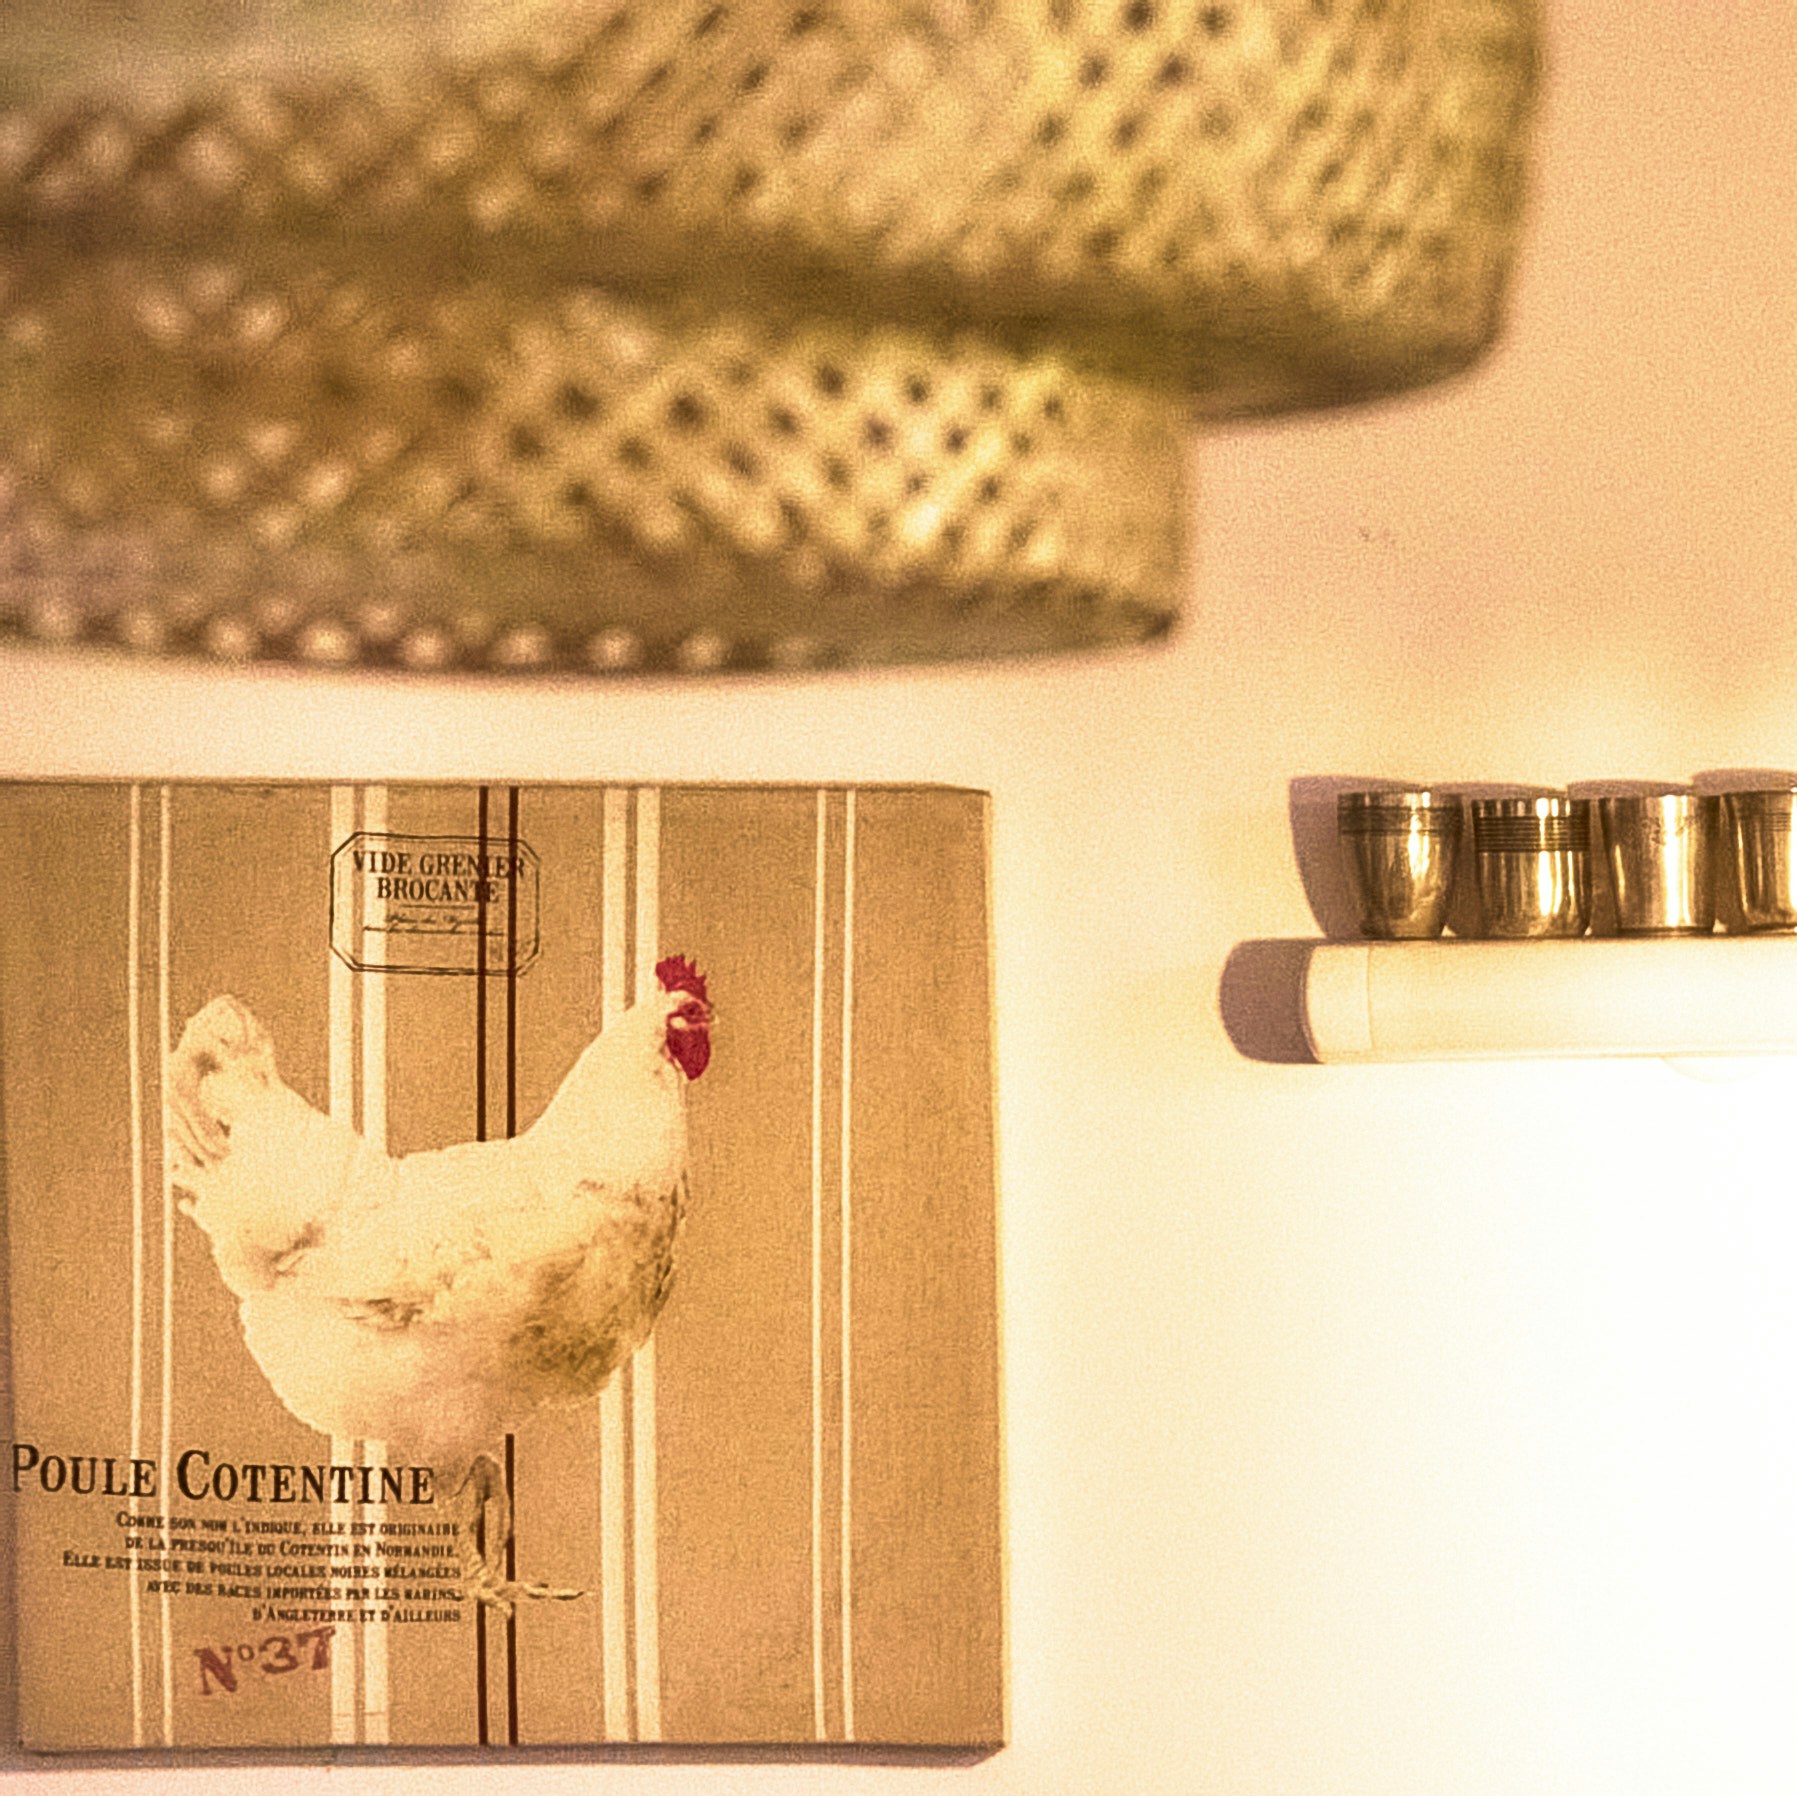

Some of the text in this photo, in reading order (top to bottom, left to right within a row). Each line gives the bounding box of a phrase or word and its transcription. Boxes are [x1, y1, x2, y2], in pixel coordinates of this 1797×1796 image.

[352, 850, 412, 875] VIDE
[377, 877, 500, 903] BROCANTE
[12, 1443, 435, 1505] POULE COTENTINE
[351, 1523, 375, 1536] EST
[380, 1523, 460, 1536] ORIGINAIRE
[125, 1537, 143, 1549] DE
[149, 1538, 165, 1549] LA
[279, 1541, 349, 1557] COTENTIN
[354, 1544, 370, 1556] EN
[266, 1565, 326, 1578] LOCALES
[186, 1582, 213, 1595] DES
[218, 1583, 261, 1598] RACES
[375, 1587, 399, 1600] LES
[359, 1609, 375, 1622] ET
